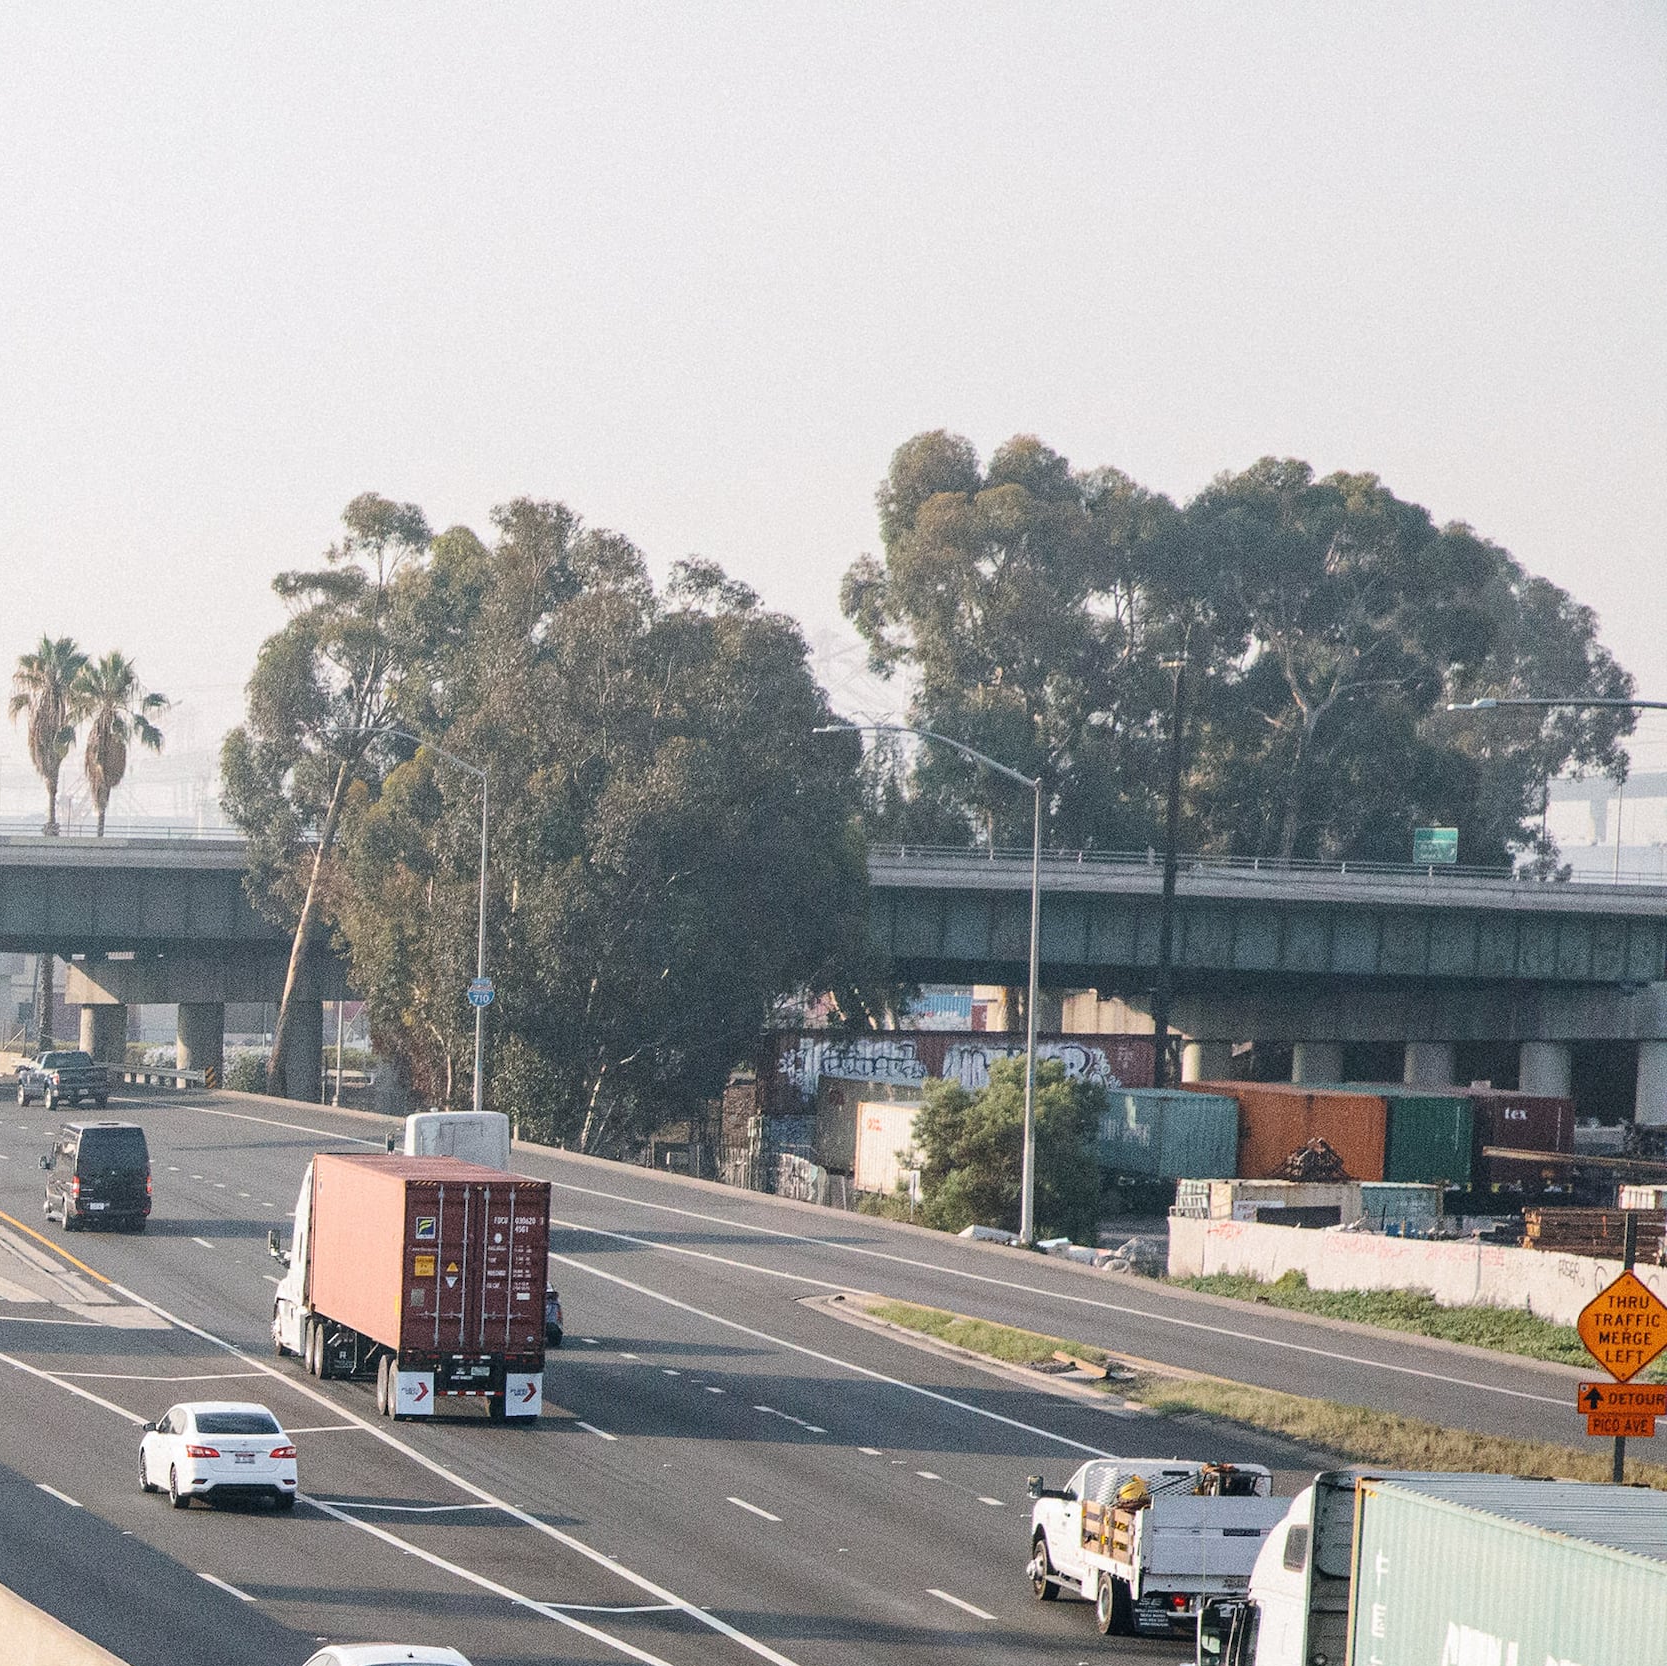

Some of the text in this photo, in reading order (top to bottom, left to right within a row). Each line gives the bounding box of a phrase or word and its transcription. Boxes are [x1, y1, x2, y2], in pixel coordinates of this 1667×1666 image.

[1608, 1296, 1650, 1309] THRU
[1594, 1313, 1661, 1327] TRAFFIC
[1599, 1331, 1653, 1346] MERGE
[1605, 1350, 1644, 1364] LEFT
[1608, 1393, 1666, 1406] DETOUR
[1593, 1418, 1648, 1433] PICO AVE
